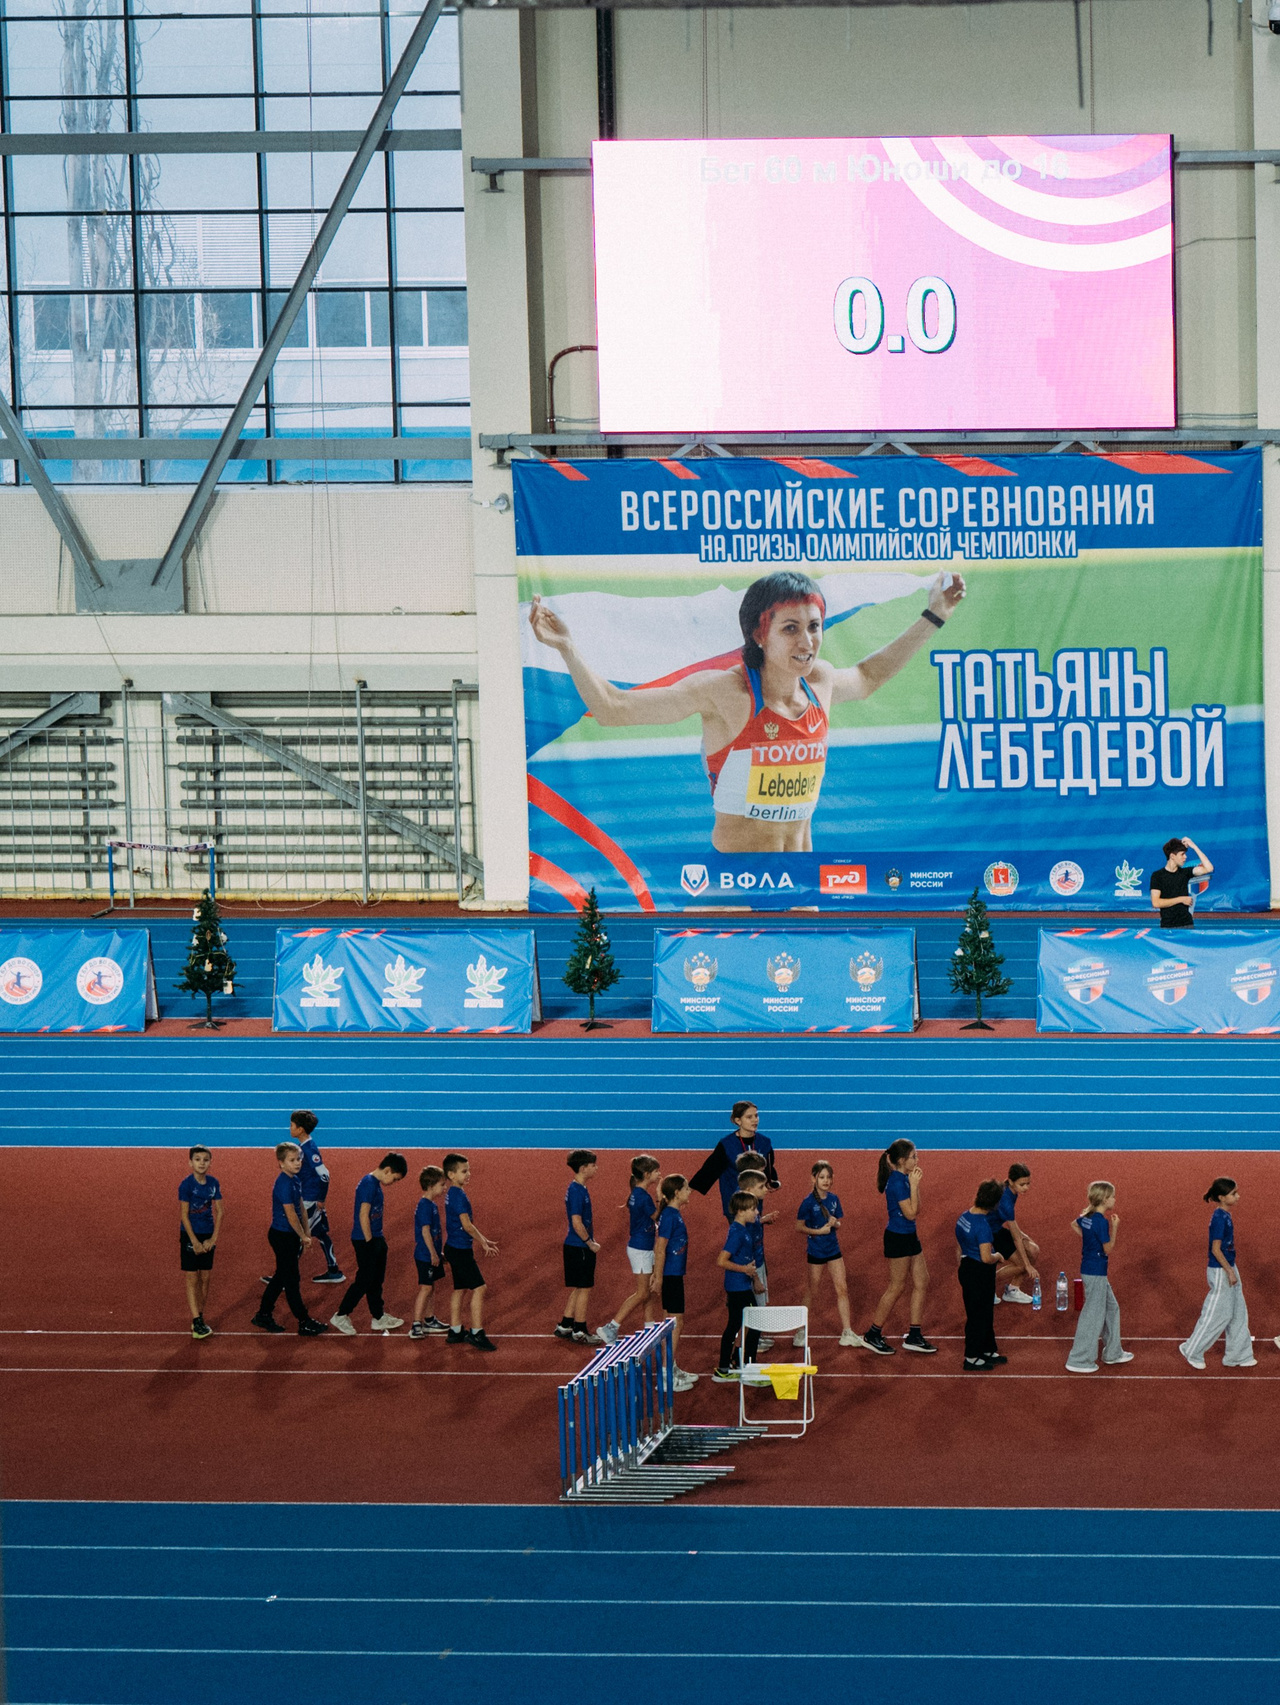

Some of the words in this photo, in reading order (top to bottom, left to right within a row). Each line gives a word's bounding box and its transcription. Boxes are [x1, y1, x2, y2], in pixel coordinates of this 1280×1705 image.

[700, 156, 755, 184] Бег
[764, 155, 801, 182] 60
[813, 162, 837, 183] м
[847, 155, 970, 182] Юноши
[980, 158, 1023, 183] до
[832, 275, 957, 355] 0.0
[620, 481, 885, 531] ВСЕРОССИЙСКИЕ
[899, 483, 1155, 531] СОРЕВНОВАНИЯ
[700, 534, 725, 561] НА
[731, 533, 800, 561] ПРИЗЫ
[805, 527, 953, 560] ОЛИМПИЙСКОЙ
[956, 529, 1078, 559] ЧЕМПИОНКИ
[933, 650, 1166, 719] ТАТЬЯНЫ
[755, 742, 826, 763] TOYOTA
[938, 707, 1225, 796] ЛЕБЕДЕВОЙ
[719, 872, 794, 889] ВФЛА
[910, 871, 953, 879] МИНСПОРТ
[910, 880, 943, 888] РОССИИ
[845, 996, 886, 1004] МИНСПОРТ
[850, 1004, 881, 1012] РОССИИ
